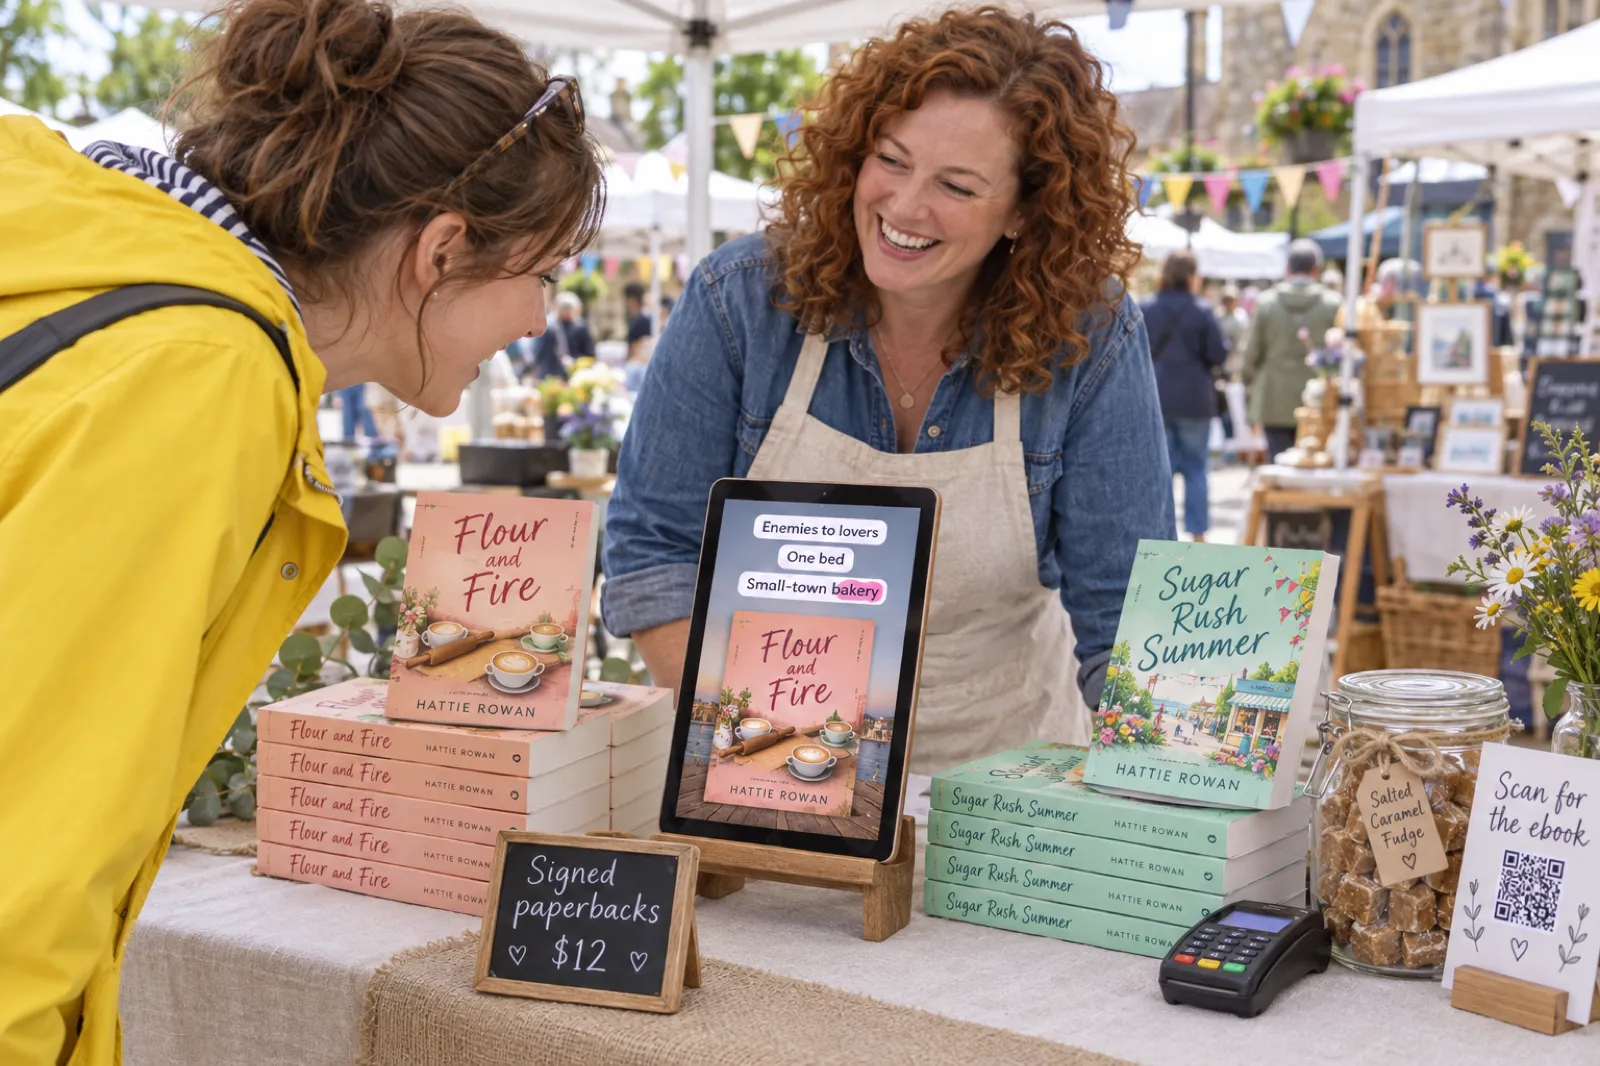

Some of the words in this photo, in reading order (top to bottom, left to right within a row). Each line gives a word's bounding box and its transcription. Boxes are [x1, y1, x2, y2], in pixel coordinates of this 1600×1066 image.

[454, 512, 548, 554] Flour
[762, 521, 819, 535] Enemies
[821, 525, 836, 536] to
[839, 525, 879, 538] lovers
[485, 547, 522, 567] and
[787, 551, 815, 564] One
[819, 552, 845, 565] bed
[463, 571, 541, 612] Fire
[747, 579, 827, 595] Small-town
[832, 582, 879, 601] bakery
[1159, 565, 1249, 605] Sugar
[1171, 595, 1247, 635] Rush
[761, 628, 838, 663] Flour
[1138, 631, 1269, 672] Summer
[786, 658, 817, 675] and
[416, 699, 470, 713] HATTIE
[477, 704, 536, 717] ROWAN
[769, 677, 833, 711] Fire
[290, 720, 328, 741] Flour
[333, 730, 354, 743] and
[360, 729, 392, 750] Fire
[425, 744, 457, 755] HATTIE
[461, 748, 495, 759] ROWAN
[290, 753, 328, 775] Flour
[333, 764, 354, 778] and
[360, 763, 392, 784] Fire
[425, 780, 456, 791] HATTIE
[460, 784, 494, 796] ROWAN
[1116, 762, 1172, 782] HATTIE
[1179, 773, 1240, 791] ROWAN
[1495, 771, 1548, 804] Scan
[1554, 781, 1588, 814] for
[290, 786, 327, 808] Flour
[332, 798, 353, 811] and
[359, 797, 391, 818] Fire
[424, 816, 455, 827] HATTIE
[458, 820, 492, 833] ROWAN
[730, 784, 776, 800] HATTIE
[780, 791, 828, 805] ROWAN
[951, 787, 989, 812] Sugar
[993, 793, 1024, 814] Rush
[1028, 800, 1078, 822] Summer
[1114, 820, 1148, 833] HATTIE
[1152, 826, 1188, 839] ROWAN
[1370, 782, 1413, 809] Salted
[1370, 804, 1425, 829] Caramel
[1489, 806, 1522, 834] the
[1529, 813, 1590, 847] ebook
[289, 819, 327, 842] Flour
[332, 831, 353, 845] and
[359, 832, 390, 854] Fire
[423, 851, 455, 863] HATTIE
[458, 856, 491, 869] ROWAN
[949, 821, 986, 847] Sugar
[990, 828, 1022, 849] Rush
[1025, 835, 1076, 858] Summer
[1111, 856, 1145, 871] HATTIE
[1149, 863, 1185, 876] ROWAN
[1381, 825, 1425, 850] Fudge
[289, 854, 327, 876] Flour
[332, 866, 352, 881] and
[359, 866, 390, 889] Fire
[423, 887, 455, 899] HATTIE
[527, 855, 617, 896] Signed
[946, 855, 984, 881] Sugar
[987, 863, 1019, 884] Rush
[1022, 870, 1073, 893] Summer
[1108, 892, 1142, 906] HATTIE
[1147, 898, 1183, 913] ROWAN
[512, 893, 660, 930] paperbacks
[946, 892, 983, 918] Sugar
[986, 900, 1018, 921] Rush
[1022, 907, 1072, 930] Summer
[1106, 929, 1140, 942] HATTIE
[1144, 936, 1173, 948] ROWA
[552, 934, 606, 973] $12
